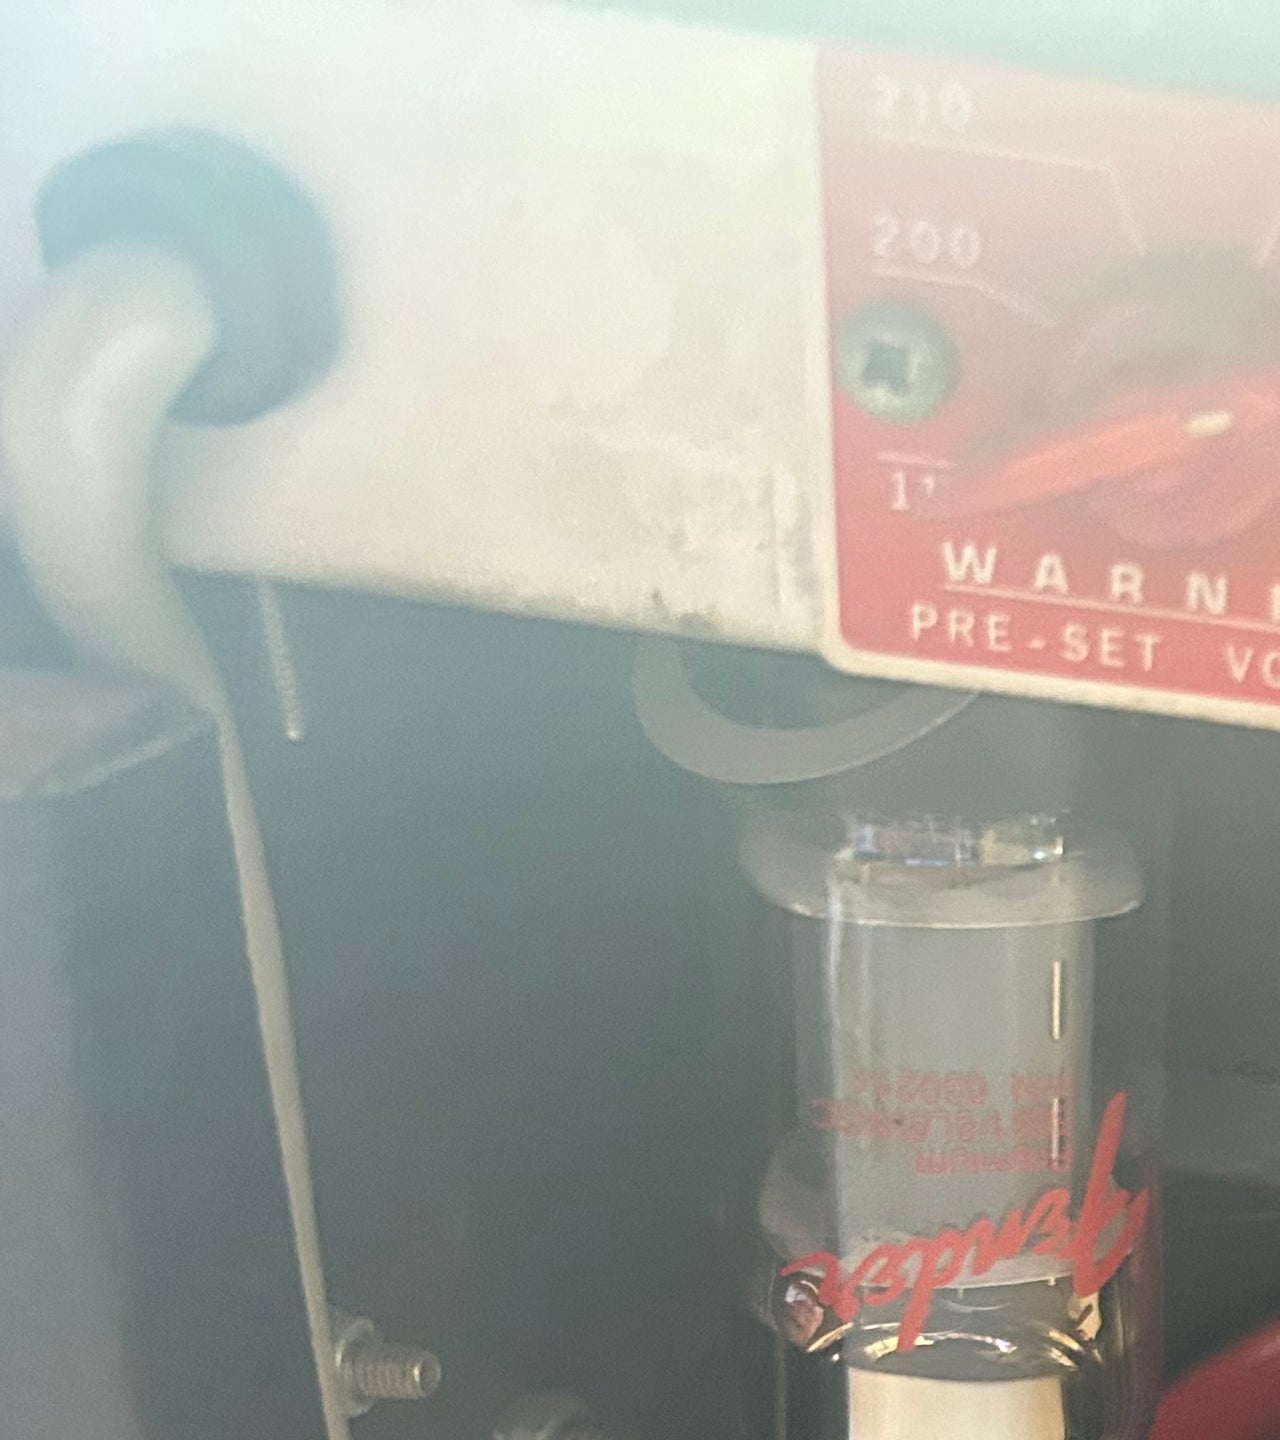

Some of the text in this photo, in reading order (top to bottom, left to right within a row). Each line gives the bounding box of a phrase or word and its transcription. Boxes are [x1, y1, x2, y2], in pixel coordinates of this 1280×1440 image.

[872, 75, 976, 134] 210
[872, 216, 981, 270] 200
[911, 602, 1164, 672] PRE-SET
[779, 1089, 1150, 1352] Fender
